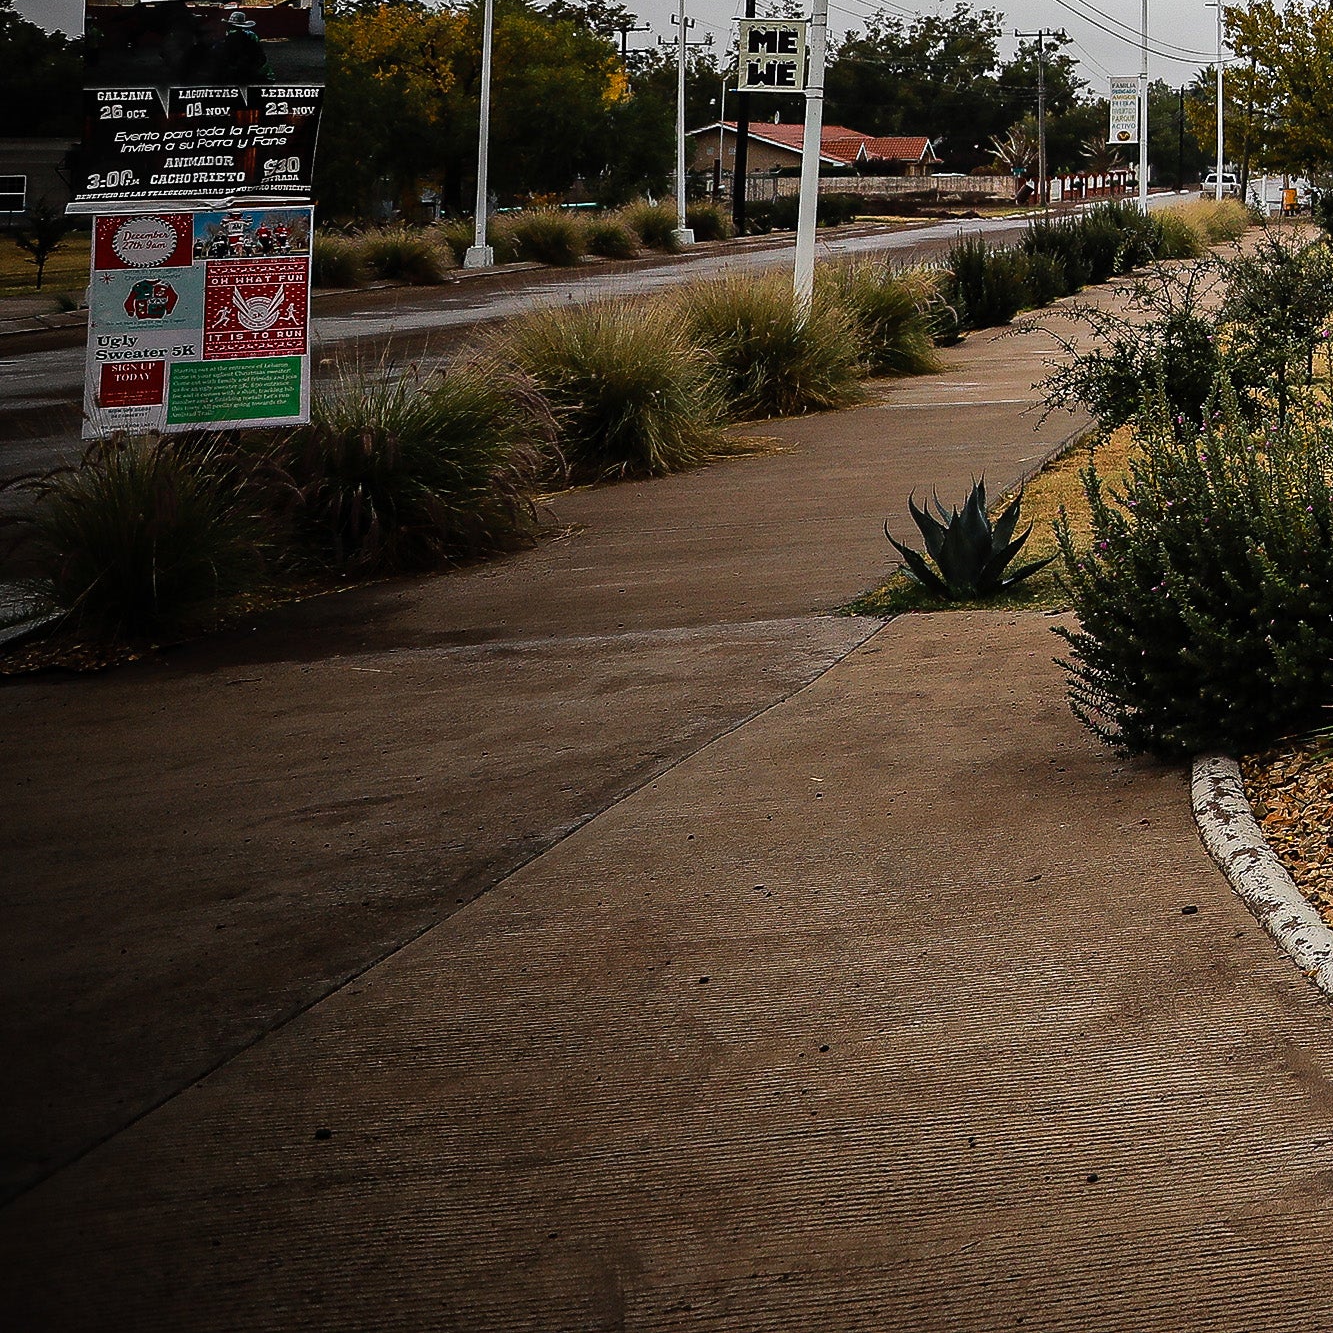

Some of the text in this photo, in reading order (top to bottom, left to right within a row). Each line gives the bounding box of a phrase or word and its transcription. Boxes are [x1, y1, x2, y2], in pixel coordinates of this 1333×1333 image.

[97, 91, 153, 101] GALEANA
[178, 89, 239, 99] LAGUNITAS
[261, 88, 319, 98] LEBARON
[100, 104, 123, 120] 26
[205, 107, 230, 116] NOV
[265, 102, 315, 116] 23 NOV
[114, 131, 159, 142] Evento
[162, 130, 193, 141] para
[196, 126, 225, 137] toda
[229, 125, 243, 136] la
[120, 136, 287, 153] Inviten a su Porra y Fans
[164, 155, 234, 168] ANIMADOR
[150, 171, 246, 185] CACHO PRIETO
[123, 231, 168, 242] December
[122, 239, 167, 250] 27th 9am
[236, 276, 271, 284] WHAT
[279, 274, 302, 282] FUN
[97, 335, 138, 348] Ugly
[209, 334, 222, 342] IT
[230, 333, 243, 341] IS
[95, 345, 195, 360] Sweater 5K
[112, 362, 155, 372] SIGN UP
[115, 372, 151, 382] TODAY
